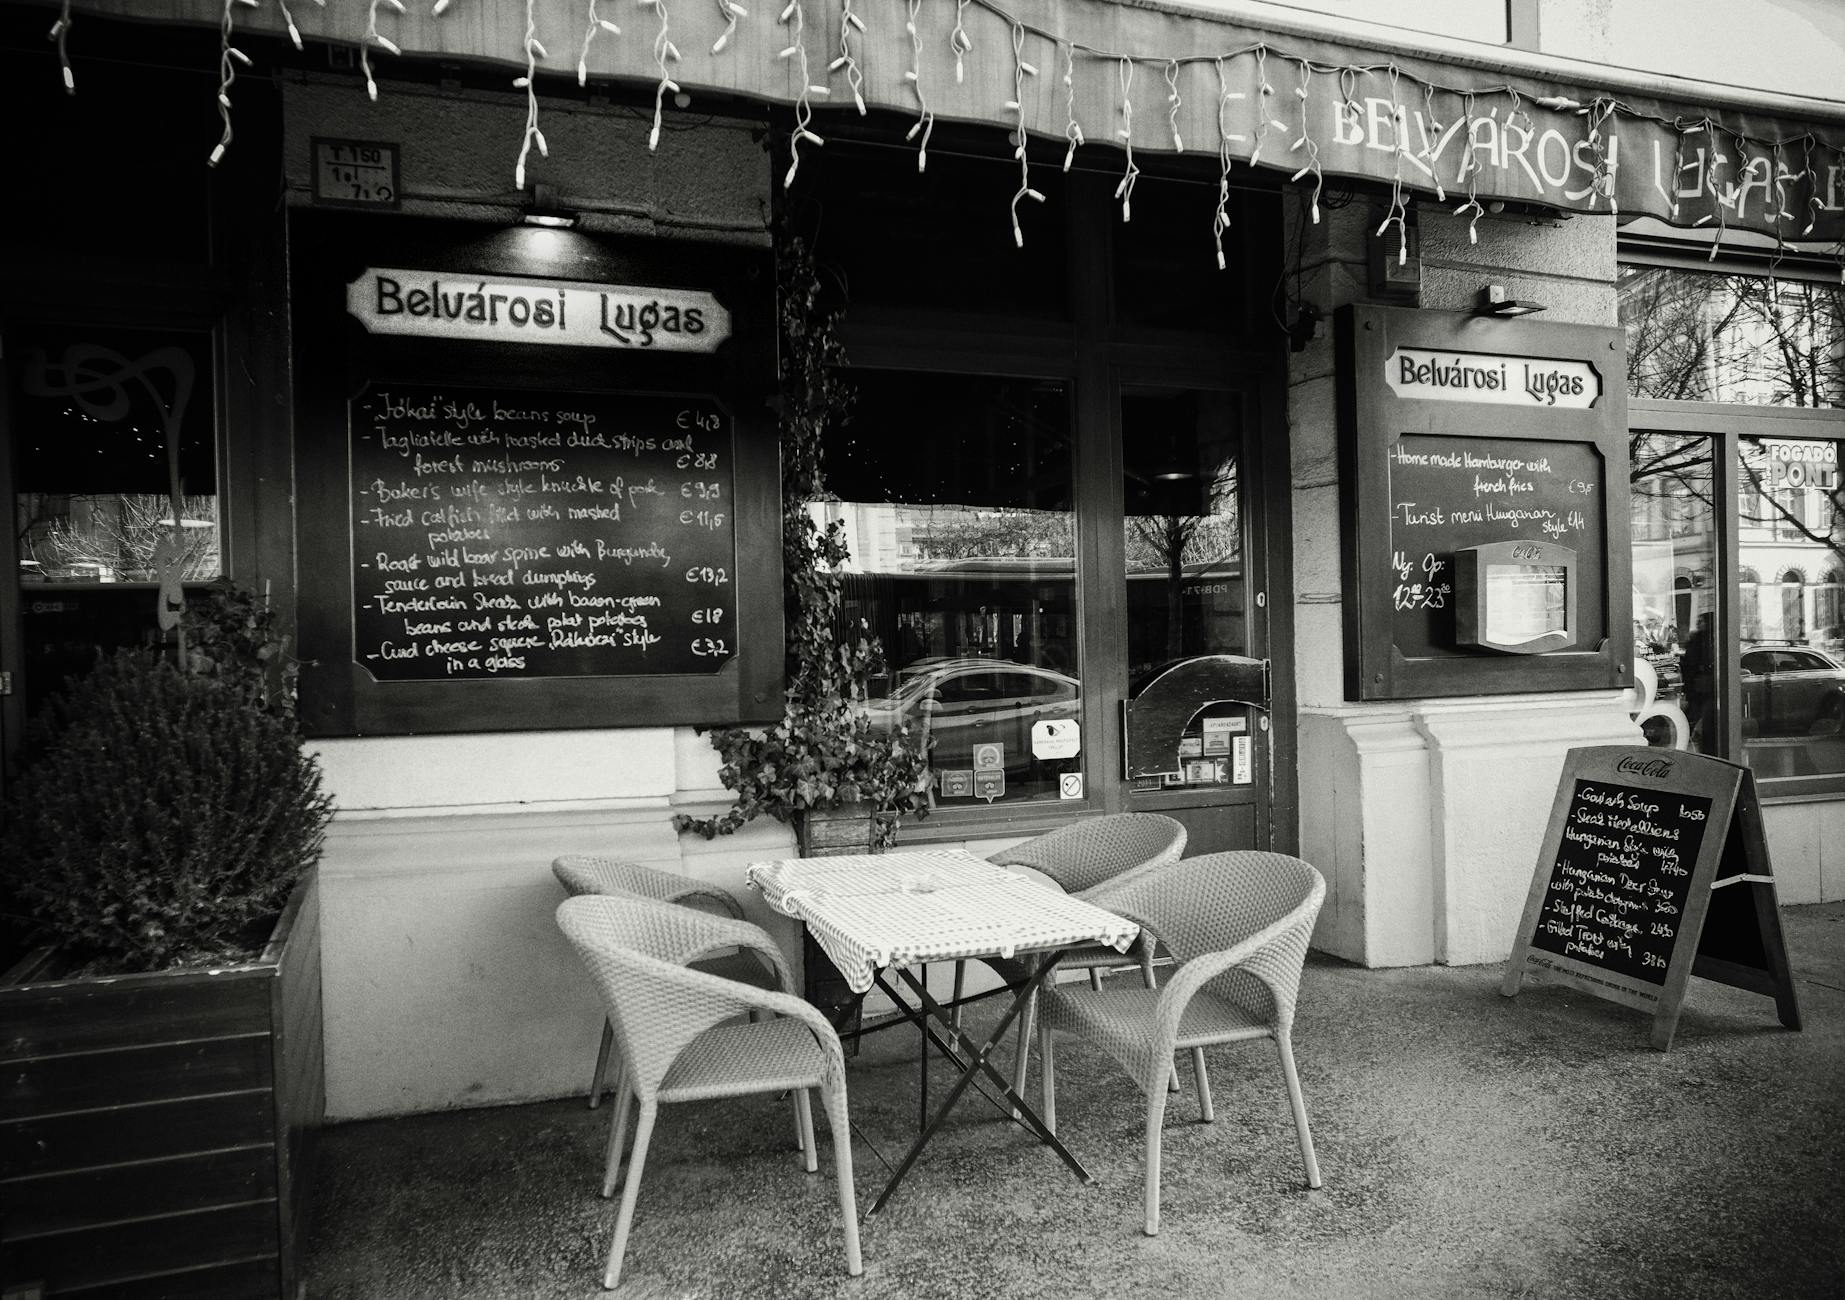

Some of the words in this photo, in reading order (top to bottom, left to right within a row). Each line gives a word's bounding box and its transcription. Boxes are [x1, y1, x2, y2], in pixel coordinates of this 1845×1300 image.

[375, 275, 566, 331] Belvárosi
[599, 291, 706, 347] Lugas
[1399, 355, 1507, 391] Belvárosi
[1524, 364, 1585, 406] Lugas
[443, 401, 486, 429] style
[493, 400, 550, 422] beans
[556, 411, 597, 434] soup
[612, 432, 657, 457] strips
[1771, 441, 1836, 462] FOGADÓ
[413, 453, 464, 476] forest
[1430, 452, 1463, 468] made
[1463, 452, 1523, 478] Hamburger
[1526, 458, 1551, 473] with
[1771, 462, 1837, 488] PONT
[451, 479, 489, 503] wife
[542, 474, 604, 493] knuckle
[609, 476, 624, 499] of
[1473, 474, 1507, 498] french
[1508, 477, 1534, 496] fries
[369, 507, 414, 527] Fried
[421, 505, 481, 528] catfish
[527, 503, 560, 521] with
[568, 502, 621, 522] mashed
[1542, 519, 1569, 540] style
[427, 549, 461, 568] wild
[463, 546, 499, 565] boar
[502, 547, 552, 570] spine
[556, 540, 591, 559] with
[384, 577, 430, 594] sauce
[434, 570, 466, 589] and
[472, 568, 515, 588] bread
[522, 569, 597, 590] dumplings
[527, 592, 563, 609] with
[403, 618, 452, 636] beans
[457, 616, 492, 633] and
[425, 639, 483, 656] cheese
[623, 628, 662, 652] style
[446, 656, 464, 675] in
[467, 657, 482, 670] a
[484, 656, 526, 673] glass
[1616, 755, 1674, 779] Coca-Cola
[1627, 794, 1659, 818] Soup
[1565, 825, 1621, 850] Hungarian
[1550, 878, 1574, 892] with
